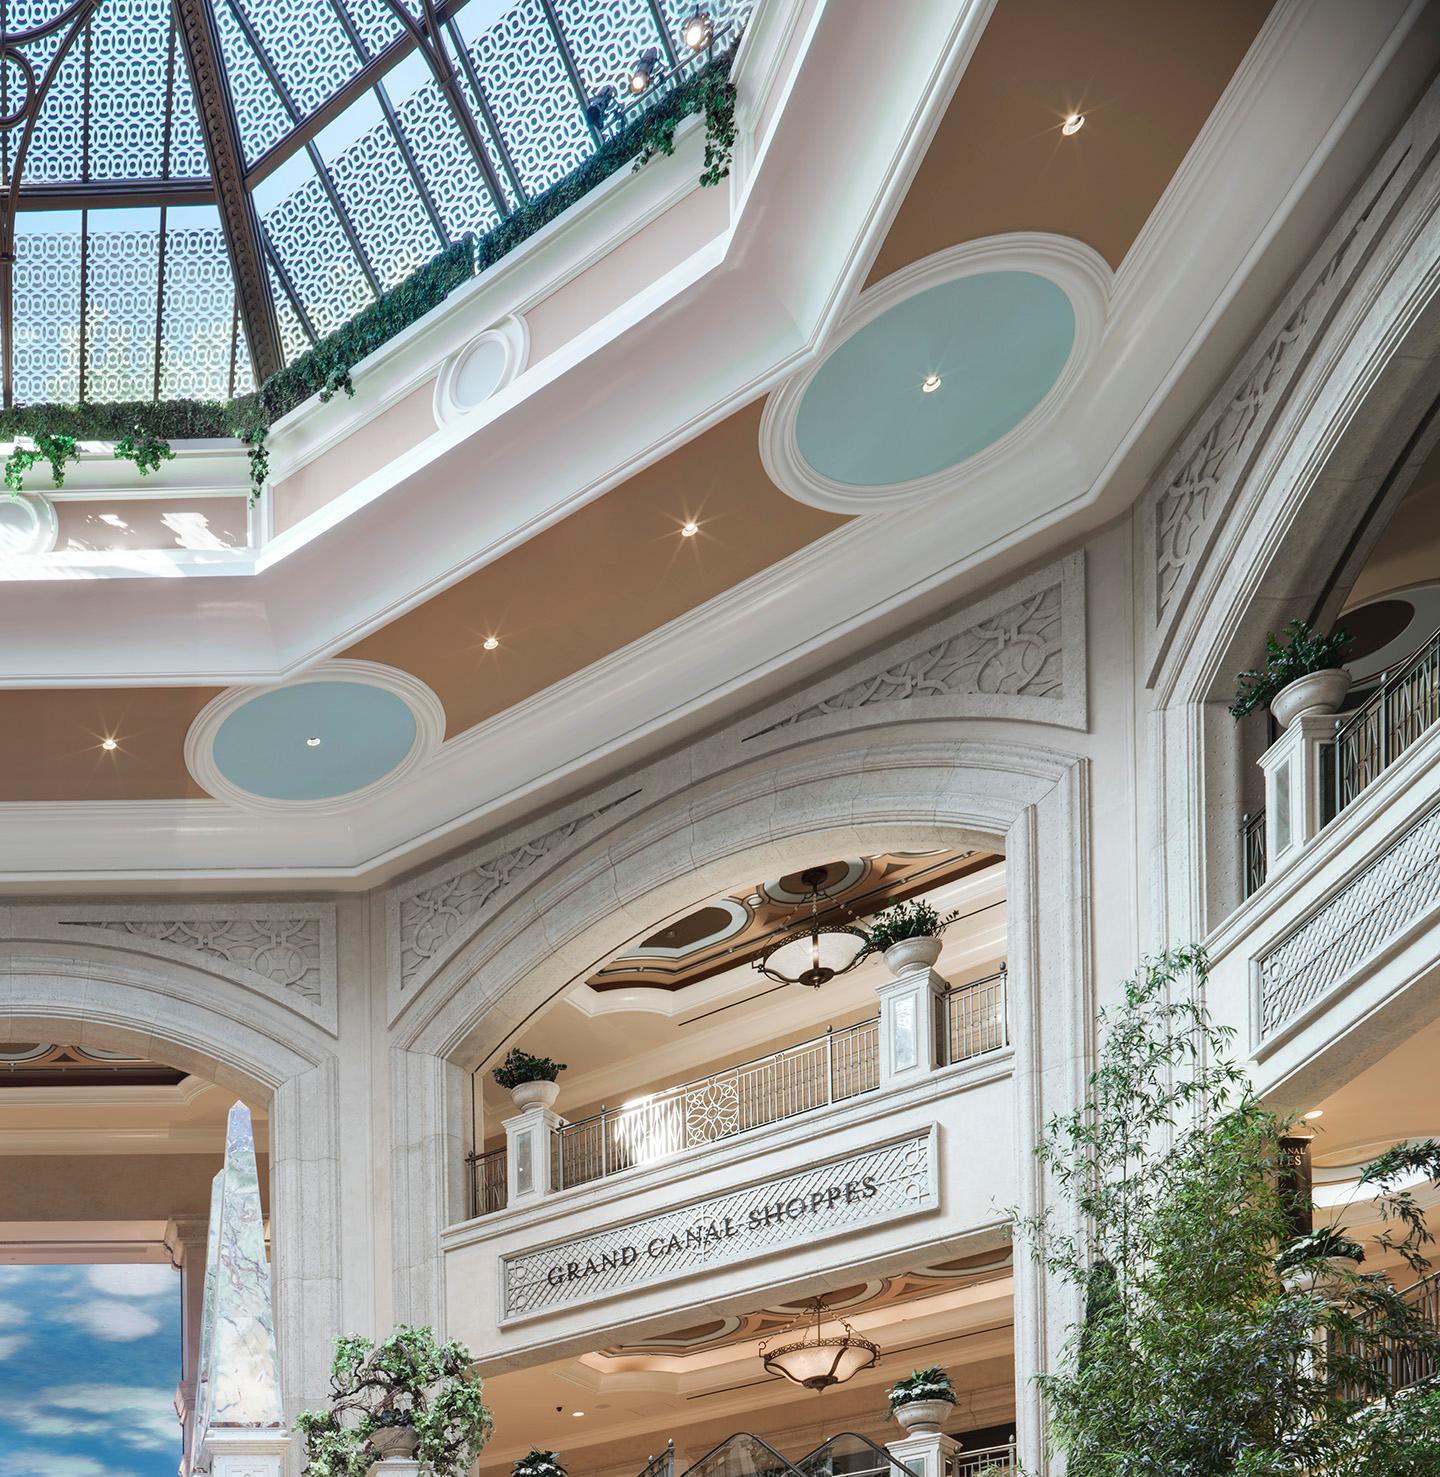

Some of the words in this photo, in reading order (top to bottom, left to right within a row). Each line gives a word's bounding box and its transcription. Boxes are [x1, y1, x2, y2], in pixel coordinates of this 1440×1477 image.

[547, 1245, 638, 1286] GRAND
[647, 1217, 739, 1259] CANAL
[747, 1176, 879, 1228] SHOPPES
